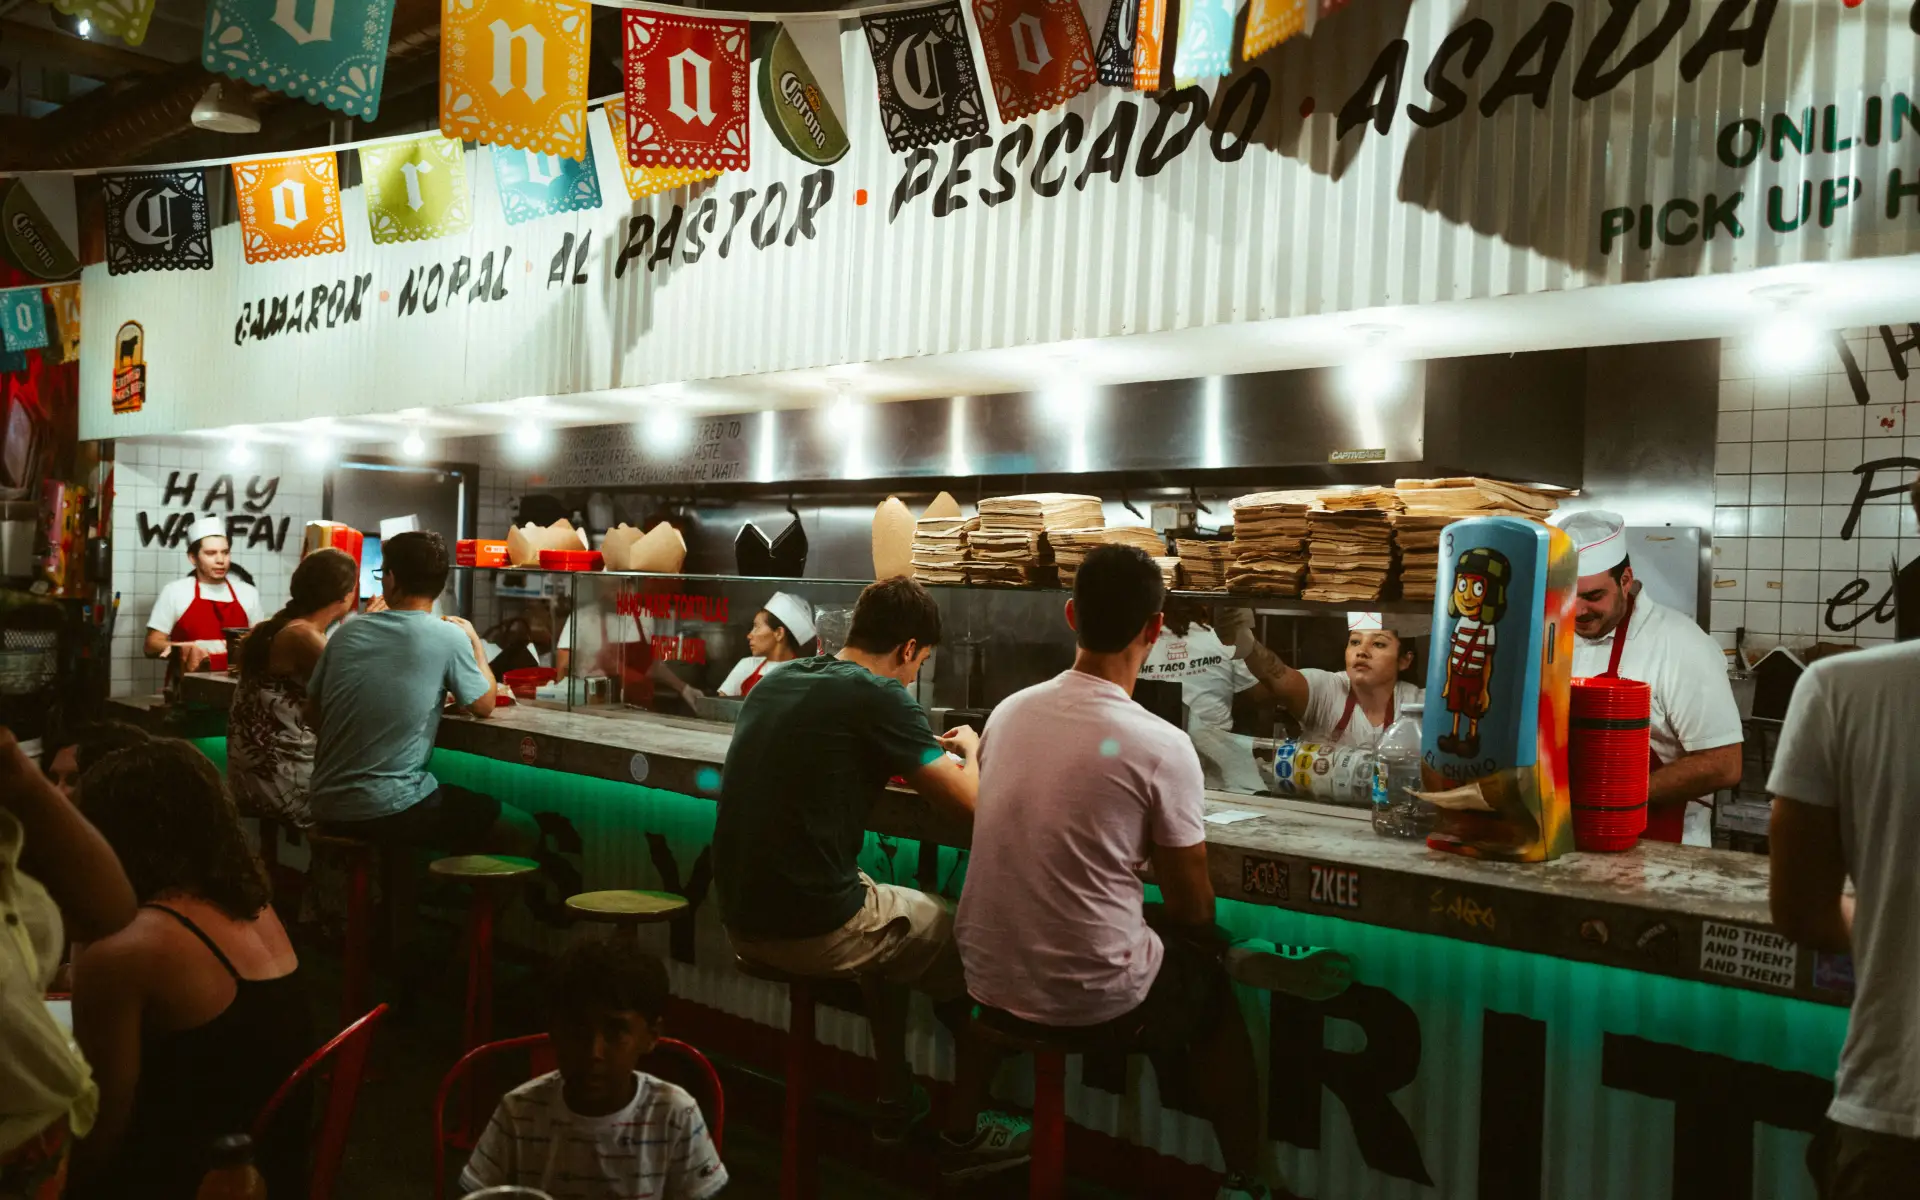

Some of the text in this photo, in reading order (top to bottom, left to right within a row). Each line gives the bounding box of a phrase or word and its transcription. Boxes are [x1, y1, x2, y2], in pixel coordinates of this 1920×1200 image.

[780, 71, 826, 150] Corona
[398, 245, 512, 318] NOPAL
[547, 228, 592, 290] AL
[614, 168, 835, 280] PASTOR
[888, 67, 1271, 225] PESCADO
[1336, 0, 1778, 142] ASADA
[1600, 191, 1745, 255] PICK
[1767, 175, 1862, 233] UP
[12, 212, 55, 270] Corona
[727, 420, 742, 439] TO
[688, 462, 708, 481] THE
[162, 471, 280, 513] HAY
[673, 594, 729, 624] TORTILLAS
[1160, 662, 1185, 672] TACO
[1190, 656, 1222, 668] STAND
[1442, 758, 1497, 779] CHAVO
[1310, 865, 1360, 907] ZKEE
[1705, 924, 1793, 951] AND THEN?
[1704, 941, 1793, 968] AND THEN?
[1703, 957, 1792, 986] AND THEN?
